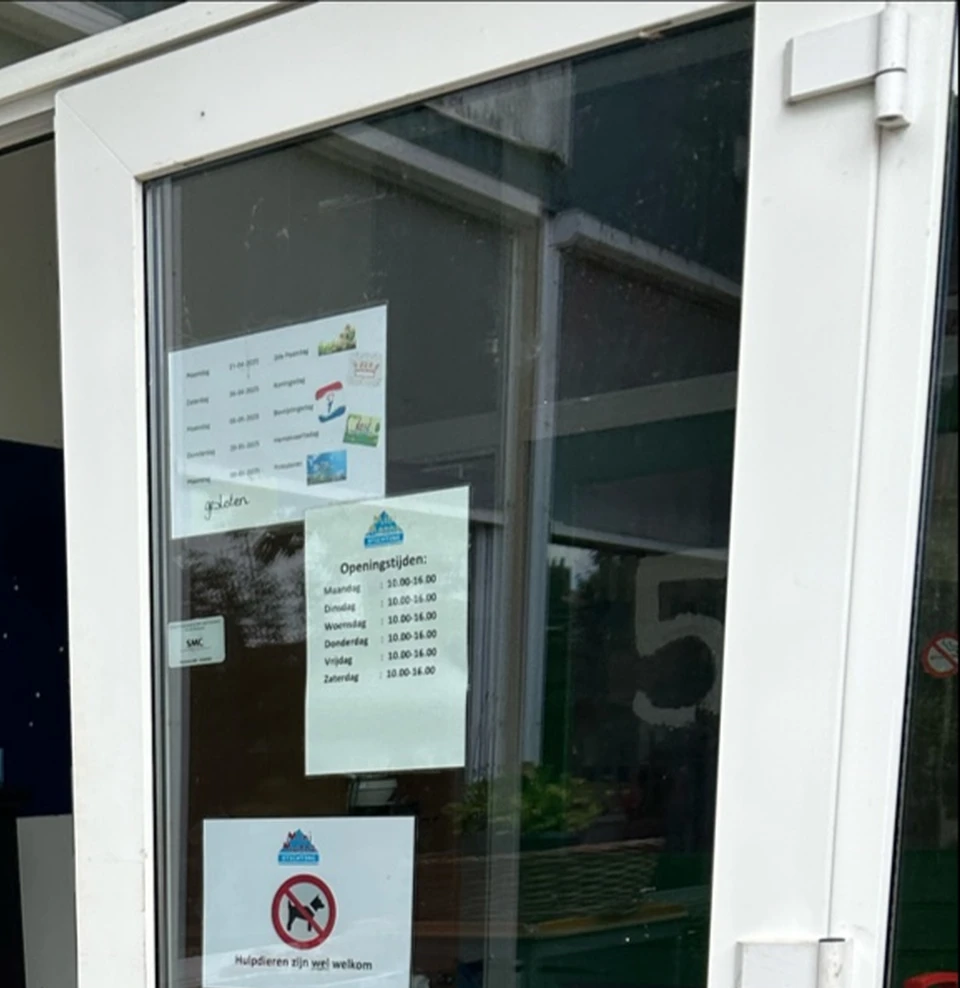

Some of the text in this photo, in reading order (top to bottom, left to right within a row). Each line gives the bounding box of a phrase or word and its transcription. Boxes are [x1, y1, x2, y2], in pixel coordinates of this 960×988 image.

[340, 554, 427, 576] Openingstijden:
[324, 583, 361, 596] Maandag
[387, 574, 437, 588] 10.00-16.00
[324, 602, 356, 614] Dinsdag
[387, 593, 437, 607] 10.00-16.00
[324, 619, 366, 631] Woensdag
[387, 611, 437, 625] 10.00-16.00
[324, 636, 369, 649] Donderdag
[388, 629, 437, 643] 10.00-16.00
[324, 655, 353, 667] Vrijdag
[388, 648, 437, 661] 10.00-16.00
[324, 672, 359, 684] Zaterdag
[386, 666, 436, 679] 10.00-16.00
[235, 956, 372, 970] Hulpdieren zijn wel welkom
